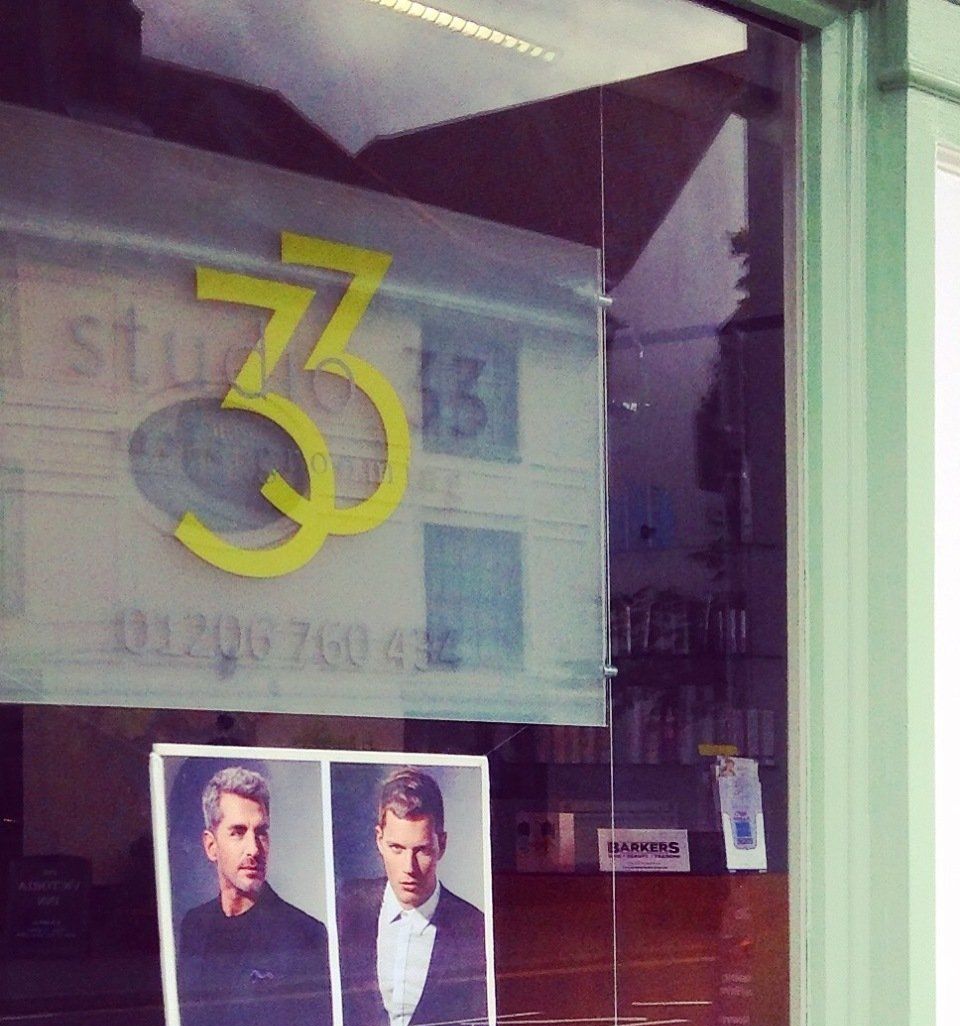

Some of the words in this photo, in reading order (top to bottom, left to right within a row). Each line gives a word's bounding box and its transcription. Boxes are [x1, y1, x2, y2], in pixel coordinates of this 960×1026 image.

[174, 231, 412, 579] 33
[290, 620, 369, 669] 760
[607, 841, 680, 854] BARKERS
